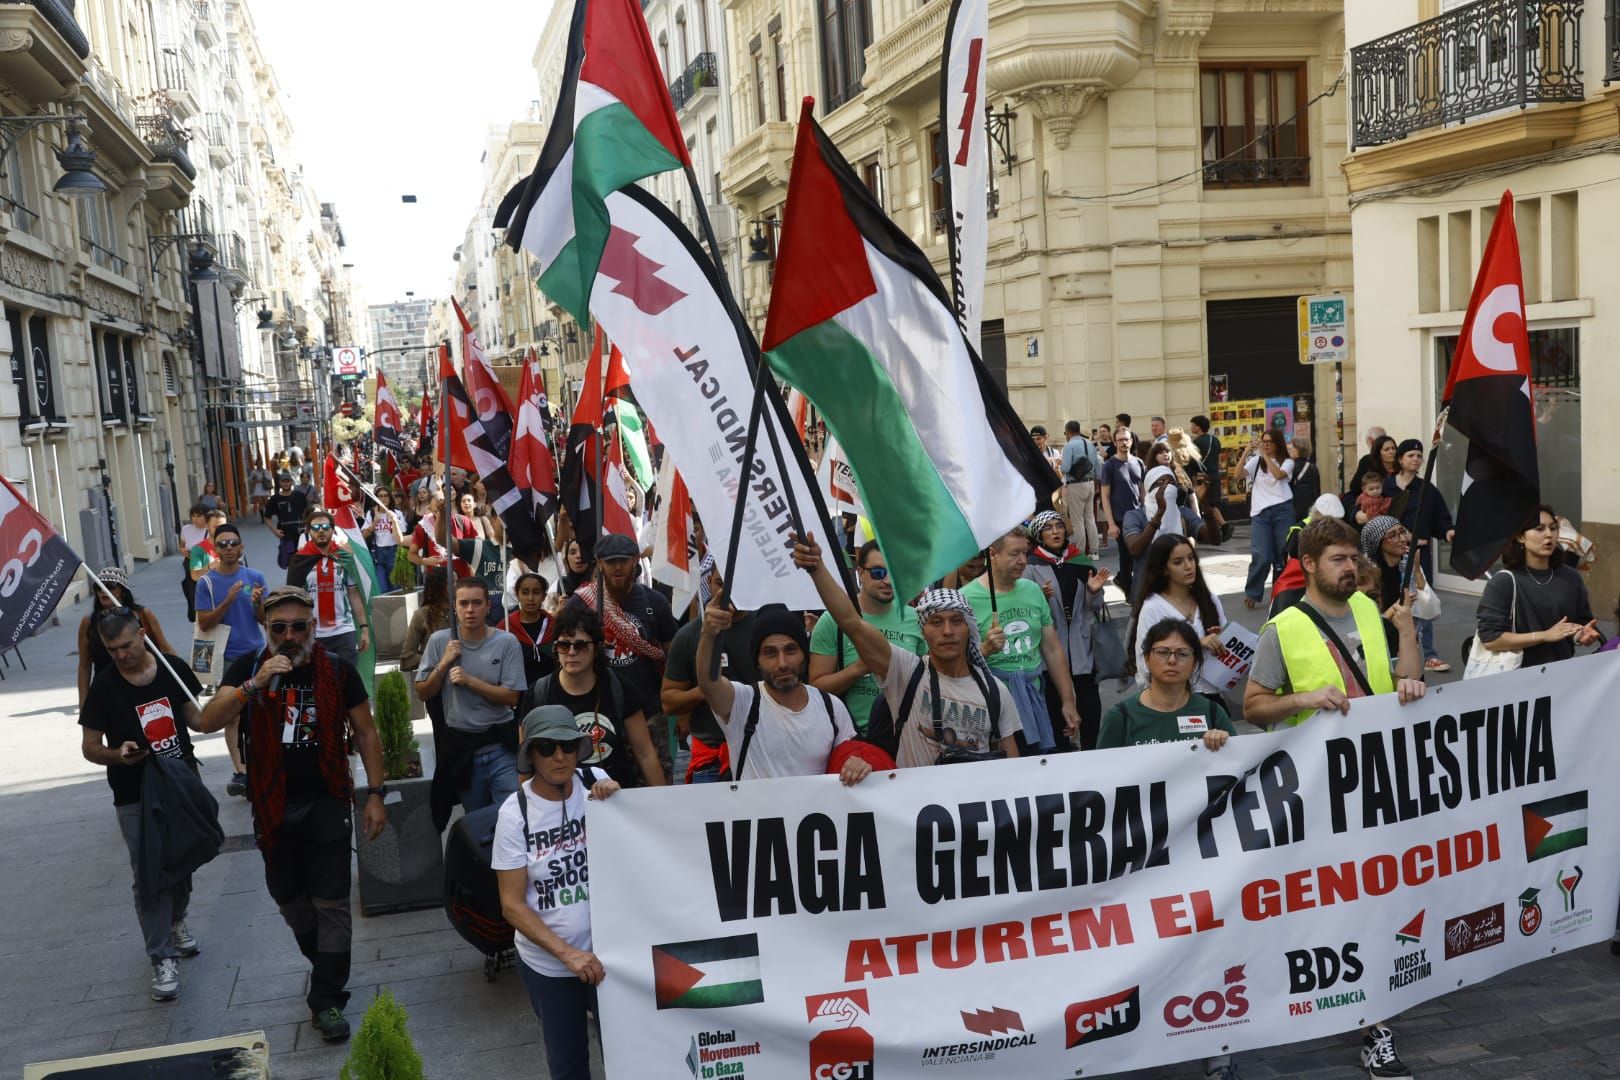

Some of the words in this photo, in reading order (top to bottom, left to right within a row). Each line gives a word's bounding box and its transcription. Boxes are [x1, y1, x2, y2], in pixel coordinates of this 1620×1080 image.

[1217, 650, 1241, 669] RET
[1225, 636, 1255, 660] DRET
[151, 735, 177, 751] CGT
[705, 812, 887, 922] VAGA
[915, 780, 1170, 905] GENERAL
[1196, 749, 1305, 859] PER
[1326, 696, 1557, 834] PALESTINA
[547, 848, 588, 877] STO
[537, 891, 556, 910] IN
[559, 884, 588, 906] GA
[844, 902, 1134, 983] ATUREM
[1150, 889, 1224, 940] EL
[1241, 823, 1501, 922] GENOCIDI
[1284, 942, 1364, 994] BDS
[1393, 951, 1419, 973] VOCES
[1420, 948, 1427, 964] X
[1389, 961, 1432, 992] PALESTINA
[1075, 1001, 1130, 1034] CNT
[1163, 984, 1250, 1029] COS
[698, 1029, 736, 1047] Global
[922, 1033, 1037, 1059] INTERSINDICAL
[699, 1041, 761, 1063] Movement
[920, 1052, 984, 1067] VALENCIANA
[701, 1065, 714, 1079] to
[716, 1061, 744, 1077] Gaza
[814, 1060, 871, 1080] CGT
